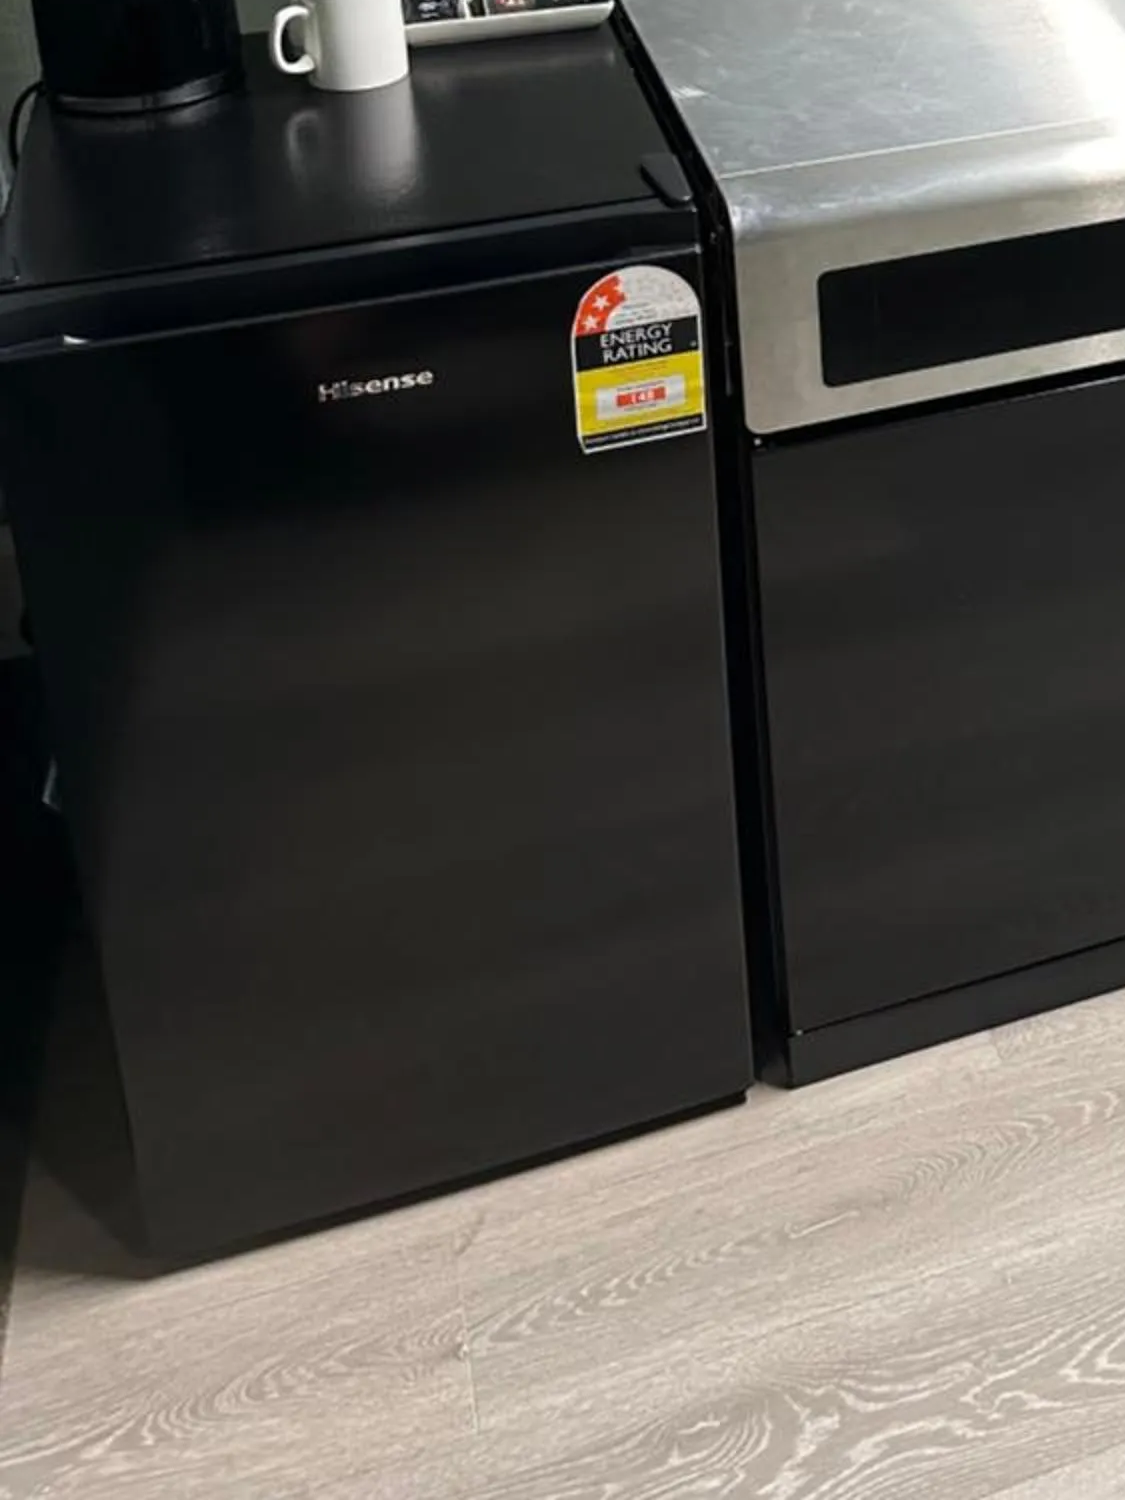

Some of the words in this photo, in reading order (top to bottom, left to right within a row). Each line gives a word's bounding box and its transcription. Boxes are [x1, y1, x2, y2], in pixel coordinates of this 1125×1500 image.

[601, 323, 672, 348] ENERGY
[603, 338, 672, 363] RATING
[318, 371, 434, 402] Hisense
